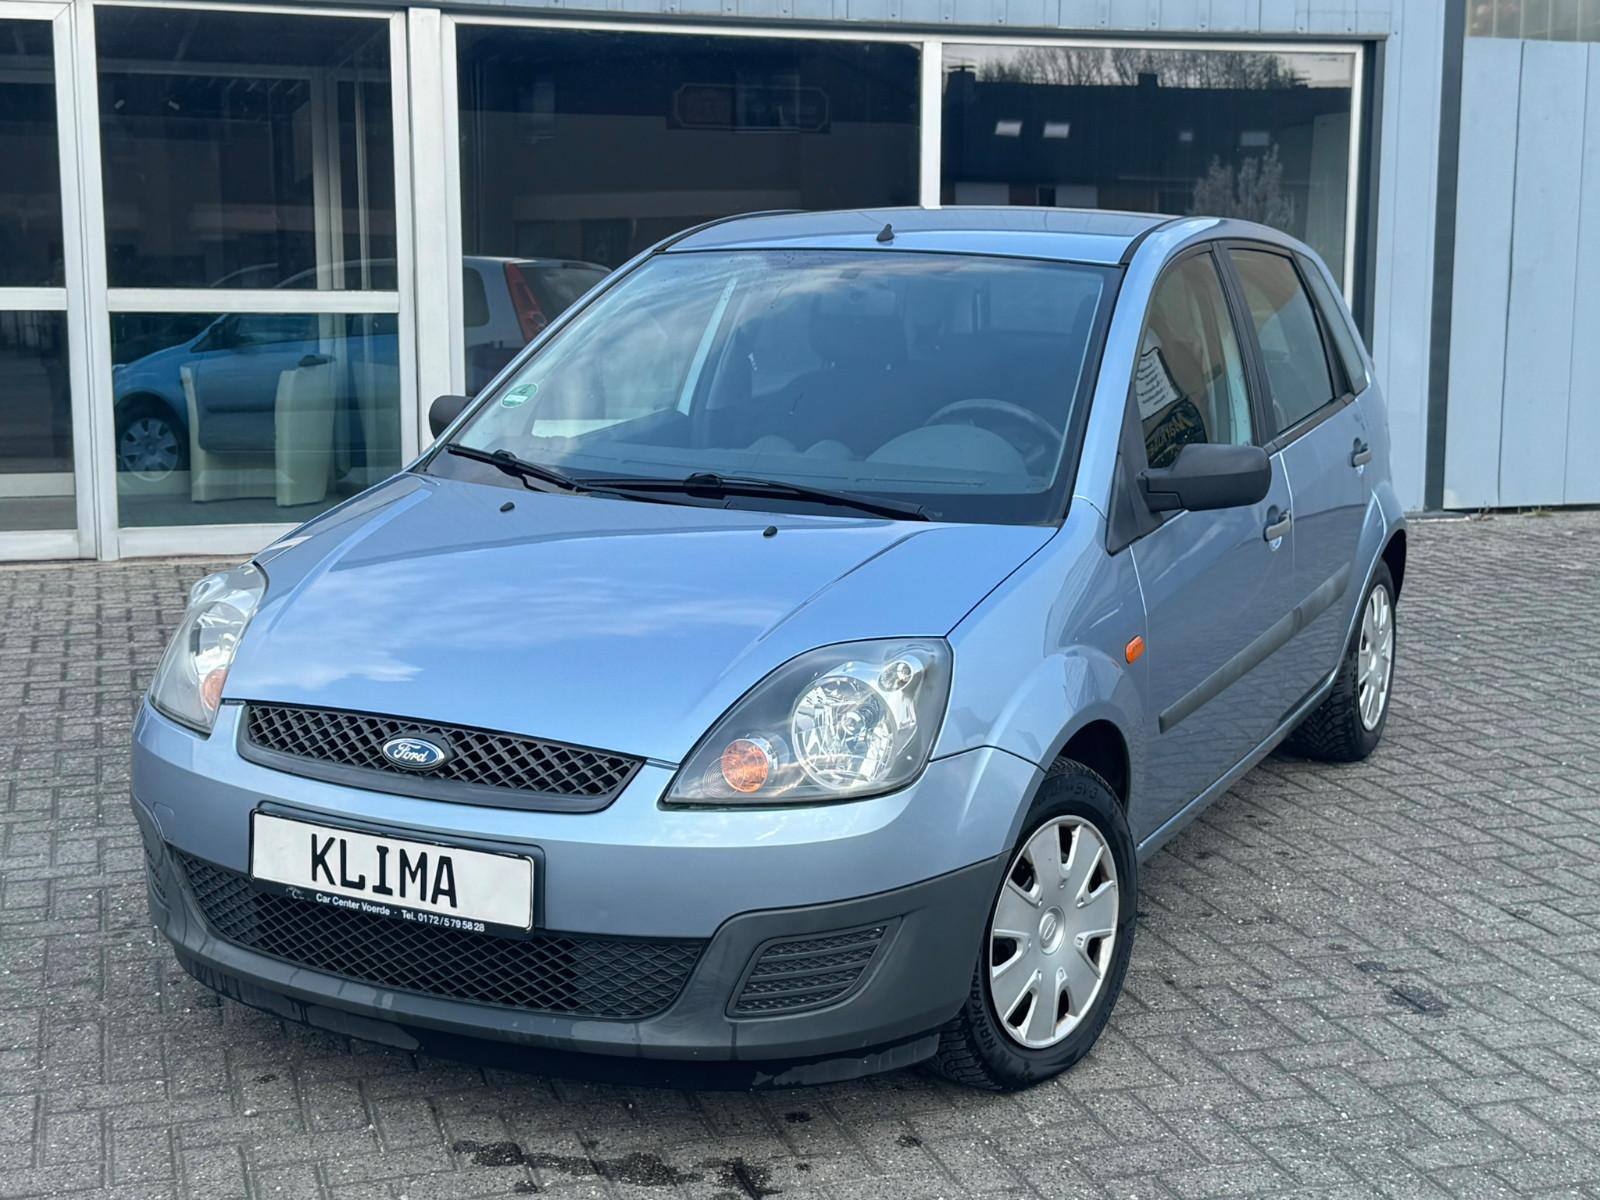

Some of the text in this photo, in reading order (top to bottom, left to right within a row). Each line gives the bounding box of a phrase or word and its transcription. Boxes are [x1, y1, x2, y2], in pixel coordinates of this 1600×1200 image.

[393, 743, 430, 762] Ford
[311, 833, 458, 909] KLIMA
[315, 892, 331, 904] Car
[332, 896, 360, 909] Center
[361, 901, 390, 916] Voerde
[401, 909, 416, 921] Tel.
